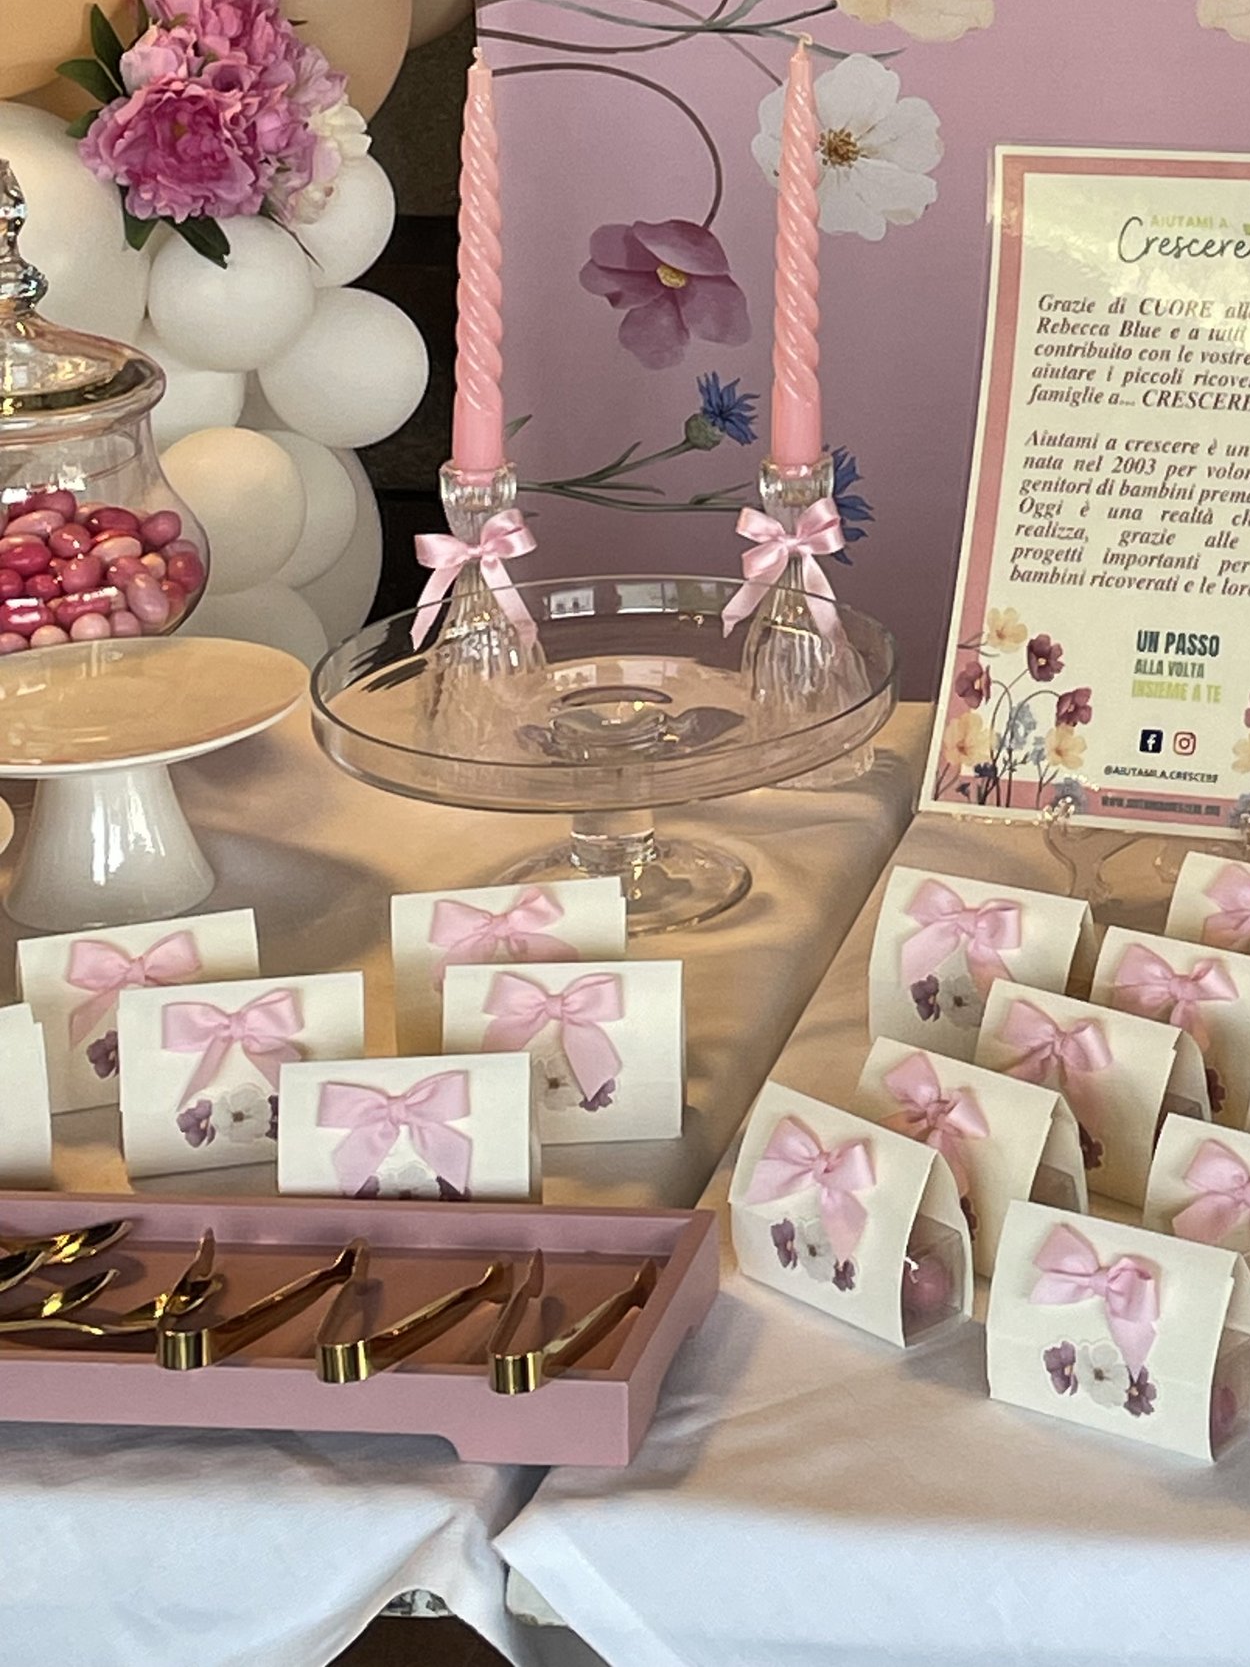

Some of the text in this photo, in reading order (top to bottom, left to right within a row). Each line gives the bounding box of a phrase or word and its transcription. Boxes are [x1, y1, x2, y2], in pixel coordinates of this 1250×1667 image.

[1151, 215, 1228, 228] AIUTAMI A
[1038, 294, 1096, 314] Grazie
[1108, 297, 1125, 315] di
[1139, 298, 1214, 319] CUORE
[1036, 317, 1109, 336] Rebecca
[1119, 321, 1161, 339] Blue
[1171, 328, 1180, 339] e
[1189, 329, 1199, 340] a
[1208, 327, 1246, 342] tutti
[1034, 342, 1132, 360] contribuito
[1139, 350, 1170, 362] con
[1177, 345, 1193, 363] le
[1032, 363, 1096, 382] aiutare
[1106, 366, 1113, 381] i
[1122, 367, 1184, 386] piccoli
[1027, 384, 1104, 407] famiglie
[1024, 429, 1101, 450] Aiutami
[1105, 439, 1117, 451] a
[1125, 439, 1200, 455] crescere
[1207, 438, 1218, 456] è
[1023, 454, 1063, 471] nata
[1074, 456, 1101, 473] nel
[1111, 456, 1156, 475] 2003
[1165, 463, 1197, 480] per
[1019, 476, 1092, 496] genitori
[1096, 477, 1114, 495] di
[1118, 480, 1195, 500] bambini
[1019, 497, 1063, 518] Oggi
[1080, 501, 1090, 518] è
[1108, 507, 1143, 521] una
[1160, 504, 1213, 524] realtà
[1015, 522, 1089, 543] realizza,
[1119, 527, 1176, 547] grazie
[1205, 530, 1239, 550] alle
[1010, 545, 1083, 564] progetti
[1102, 548, 1200, 570] importanti
[1218, 557, 1250, 575] per
[1009, 565, 1085, 586] bambini
[1090, 570, 1178, 592] ricoverati
[1185, 580, 1194, 592] e
[1200, 575, 1216, 594] le
[1137, 630, 1220, 657] UN PASSO
[1134, 659, 1204, 678] ALLA VOLTA
[1132, 680, 1221, 703] INSIEME A TE
